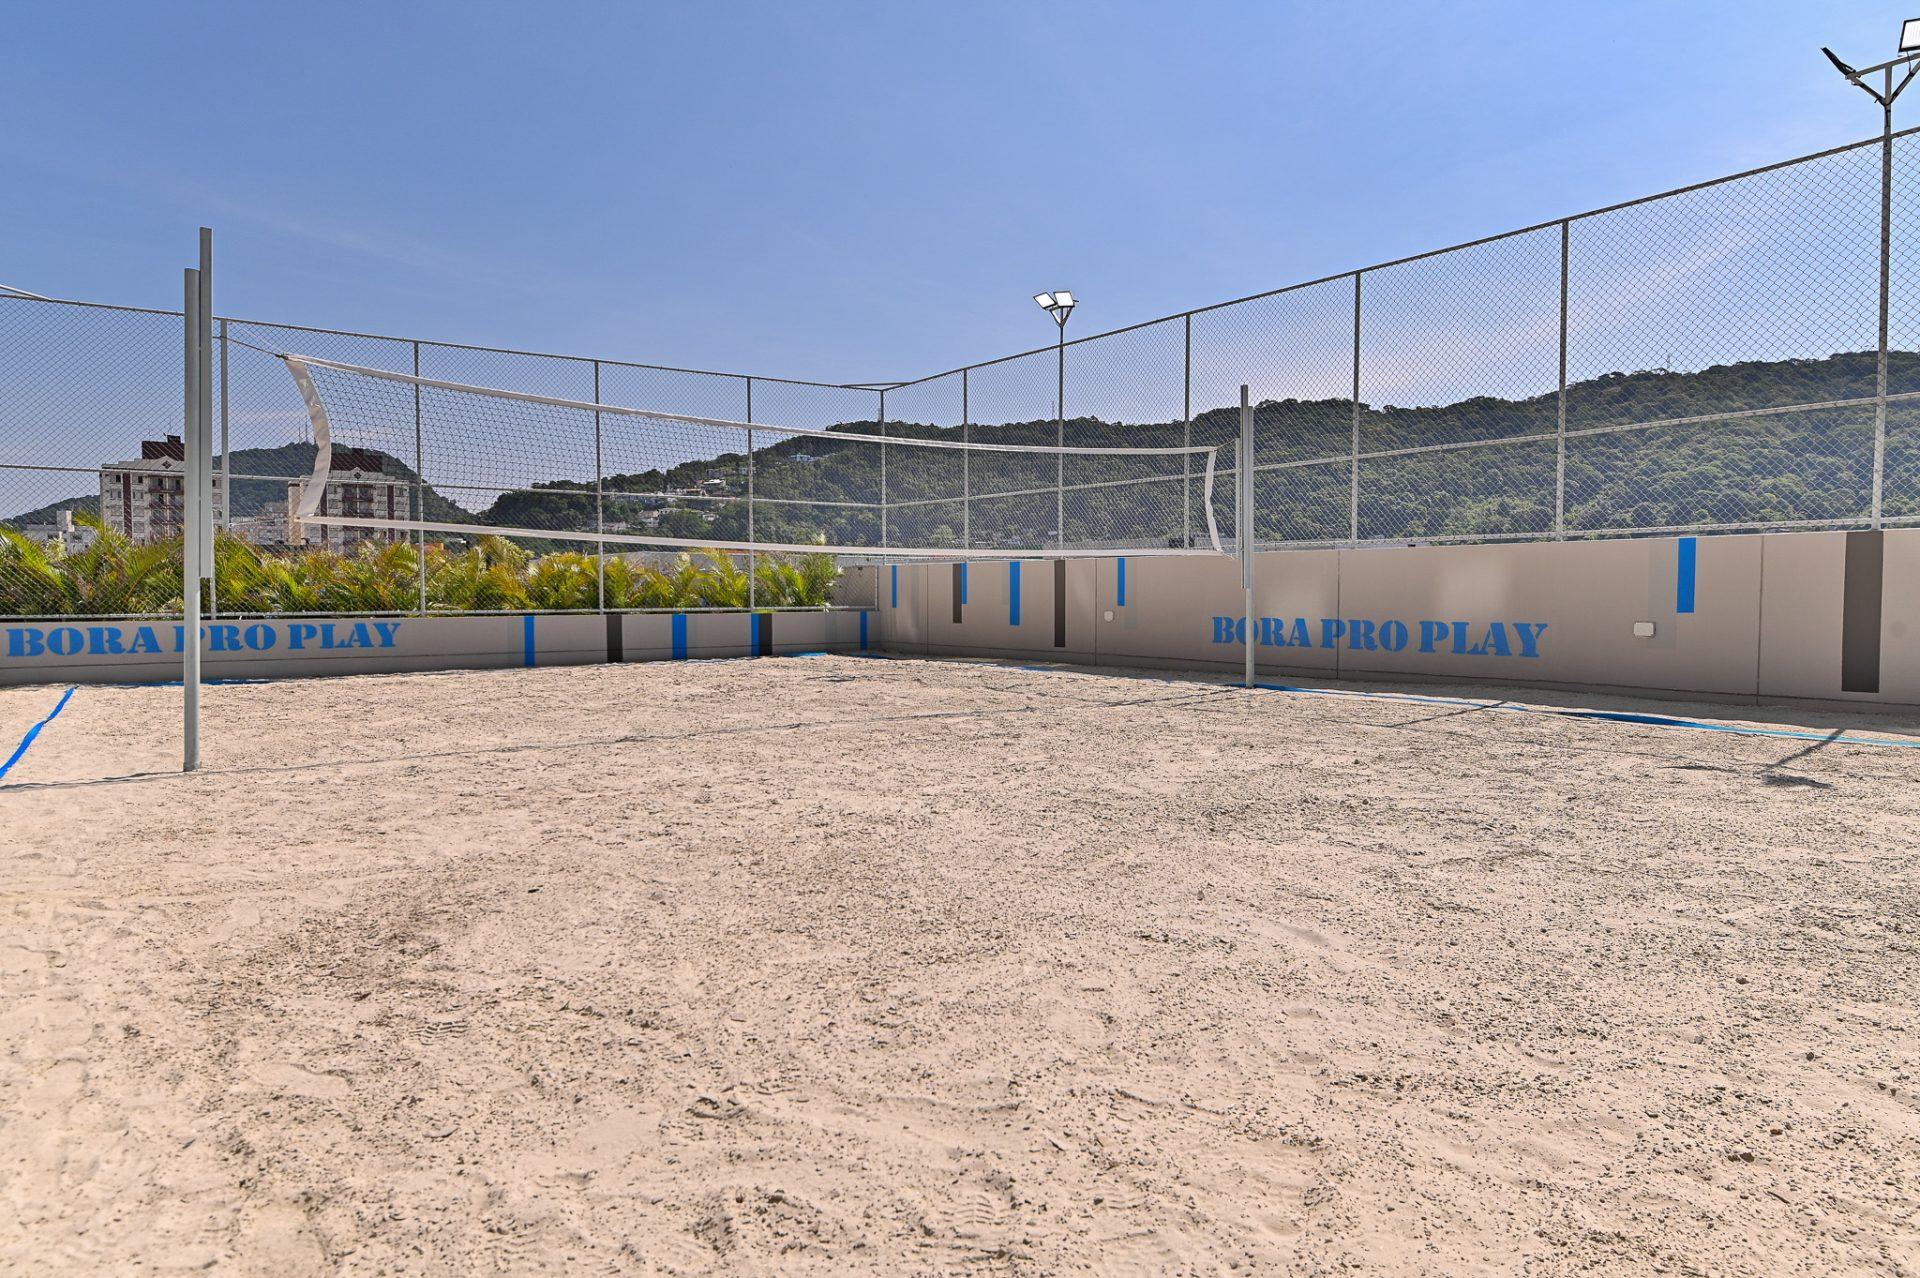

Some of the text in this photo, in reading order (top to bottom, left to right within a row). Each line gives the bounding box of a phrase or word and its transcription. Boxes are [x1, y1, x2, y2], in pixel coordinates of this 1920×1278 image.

[6, 626, 163, 657] BORA
[287, 622, 401, 650] PLAY
[1212, 616, 1549, 659] BORA PRO PLAY
